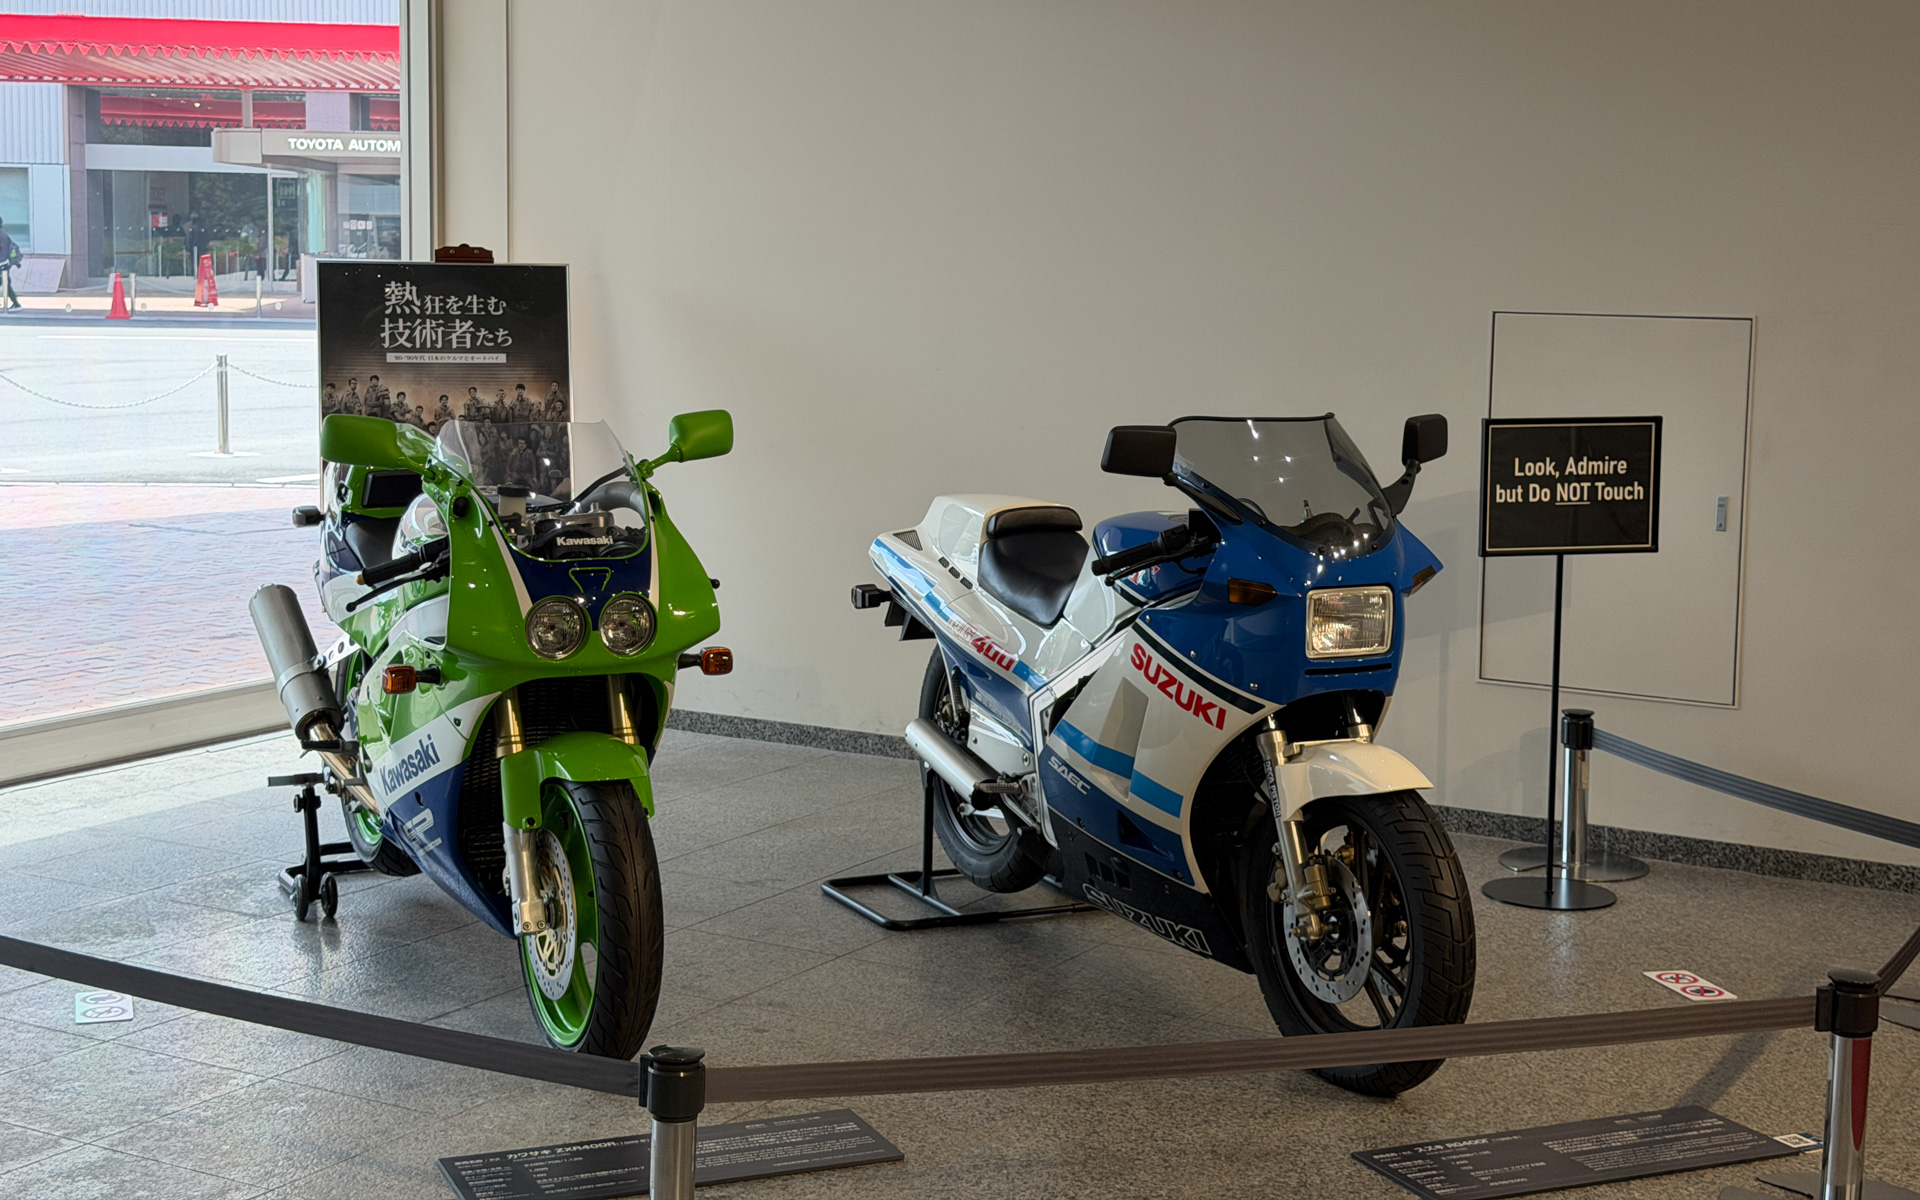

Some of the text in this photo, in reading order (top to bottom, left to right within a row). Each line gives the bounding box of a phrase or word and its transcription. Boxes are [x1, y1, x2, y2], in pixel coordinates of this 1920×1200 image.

[288, 138, 401, 152] TOYOTA AUTOM
[384, 281, 507, 316] 熱狂を生む
[380, 318, 513, 349] 技術者たち
[1514, 456, 1627, 479] Look, Admire
[1496, 481, 1644, 503] but Do NOT Touch
[556, 534, 614, 547] Kawasaki
[1130, 642, 1227, 731] SUZUKI
[379, 733, 441, 796] Kawasaki
[1047, 755, 1092, 796] SAEC
[1082, 882, 1213, 956] SUZUKI
[506, 1149, 552, 1160] カワサキ
